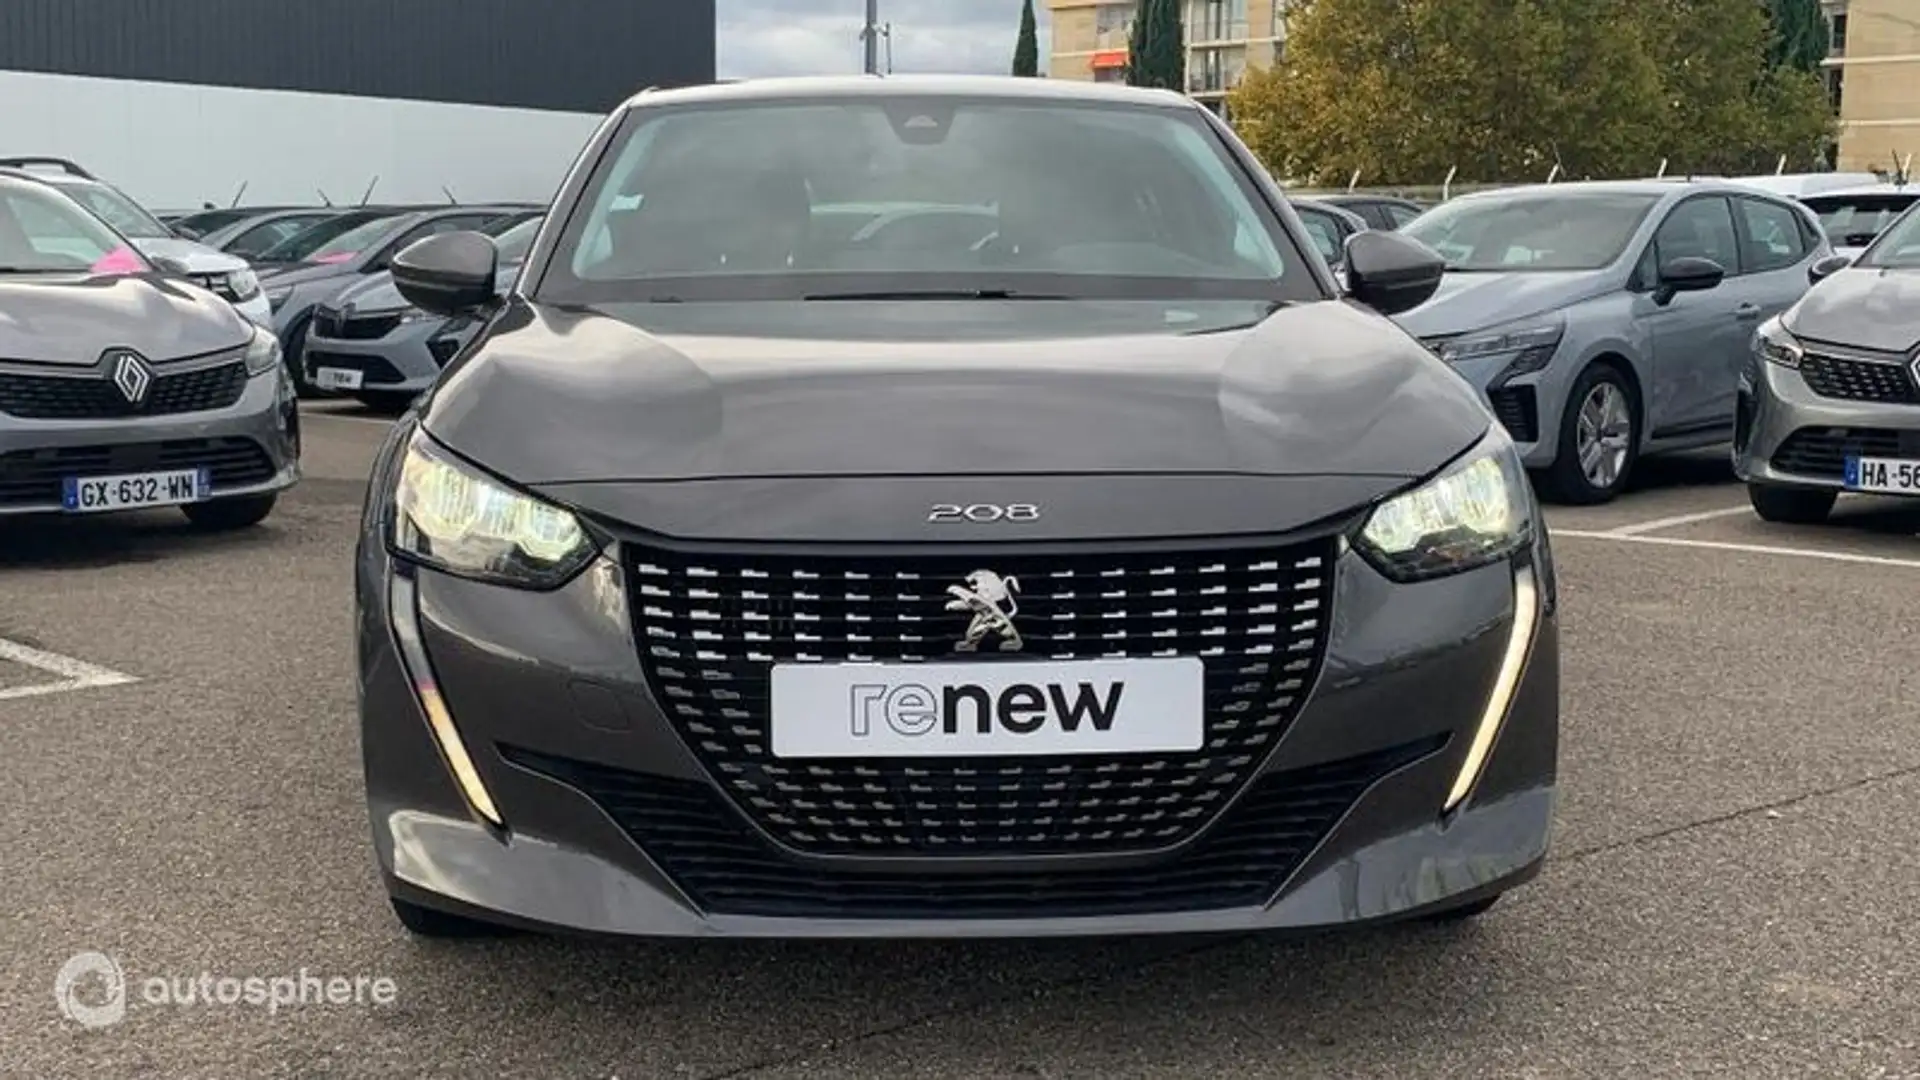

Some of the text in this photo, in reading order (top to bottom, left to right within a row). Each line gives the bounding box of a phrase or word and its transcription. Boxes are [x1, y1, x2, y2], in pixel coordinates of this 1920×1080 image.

[81, 475, 193, 507] GX-632-WN
[927, 503, 1040, 522] 208
[849, 681, 1125, 737] renew
